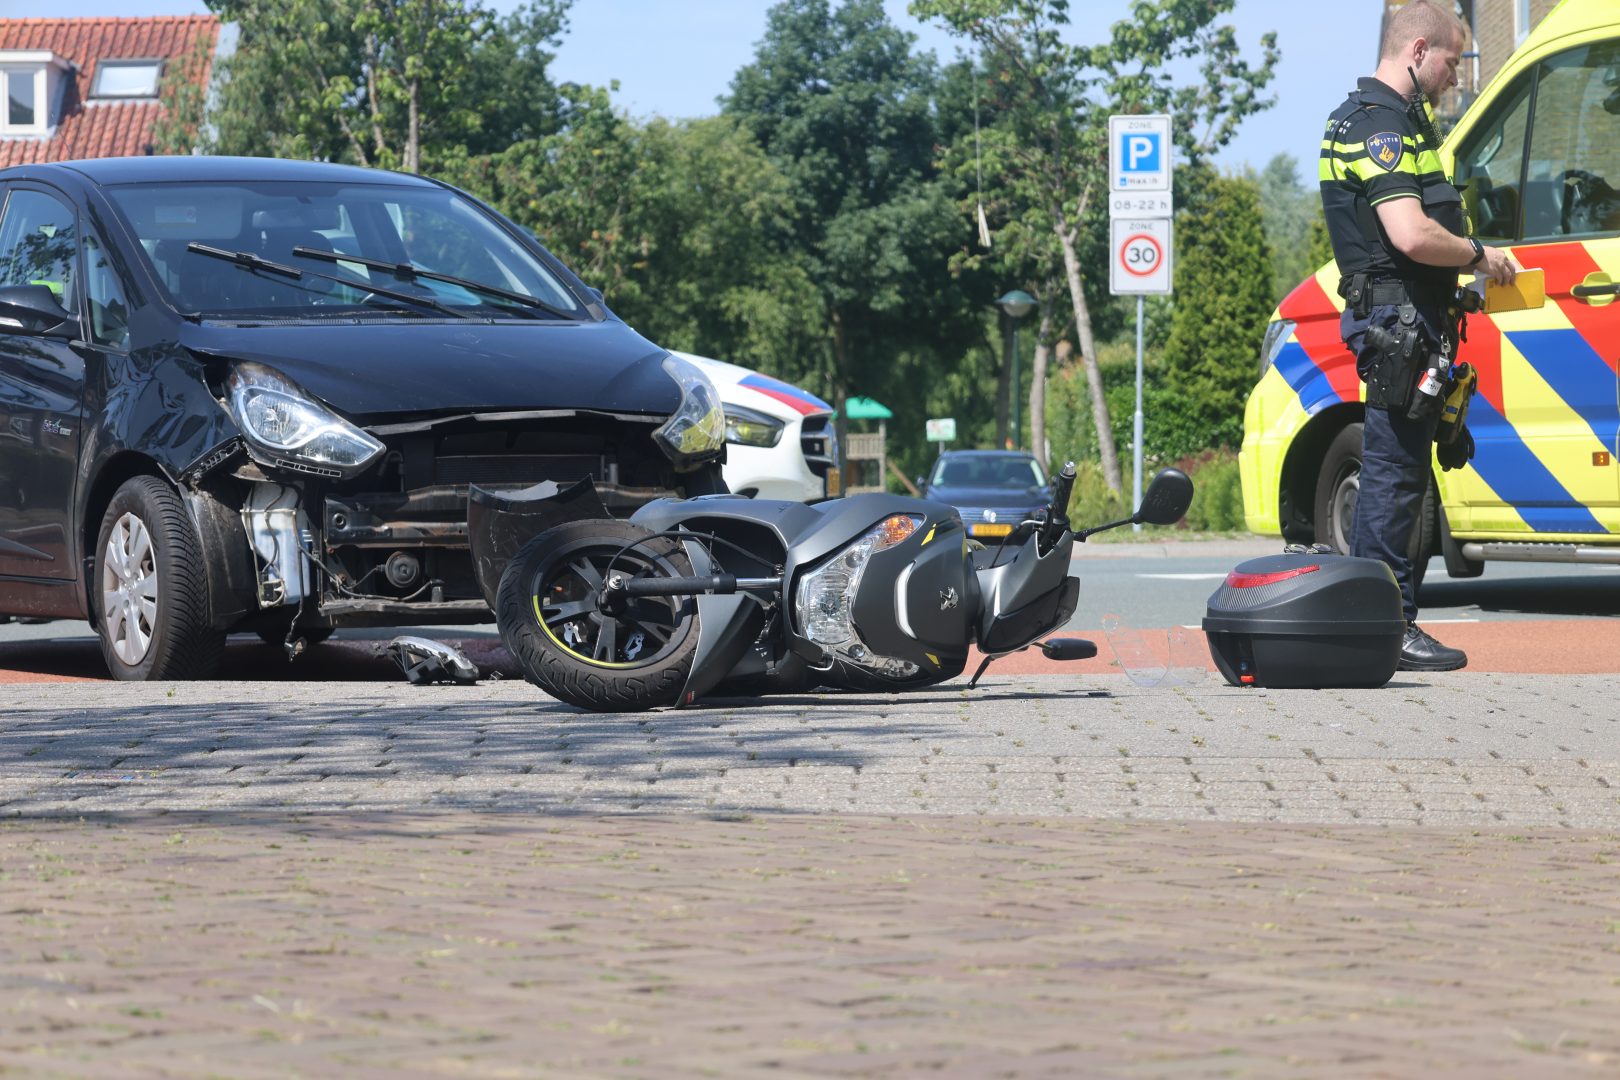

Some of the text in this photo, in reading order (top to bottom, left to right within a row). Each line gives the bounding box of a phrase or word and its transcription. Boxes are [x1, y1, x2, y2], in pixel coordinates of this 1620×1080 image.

[1128, 121, 1152, 129] ZONE
[1370, 137, 1398, 147] POLITIE
[1129, 136, 1153, 170] P
[1128, 247, 1156, 263] 30
